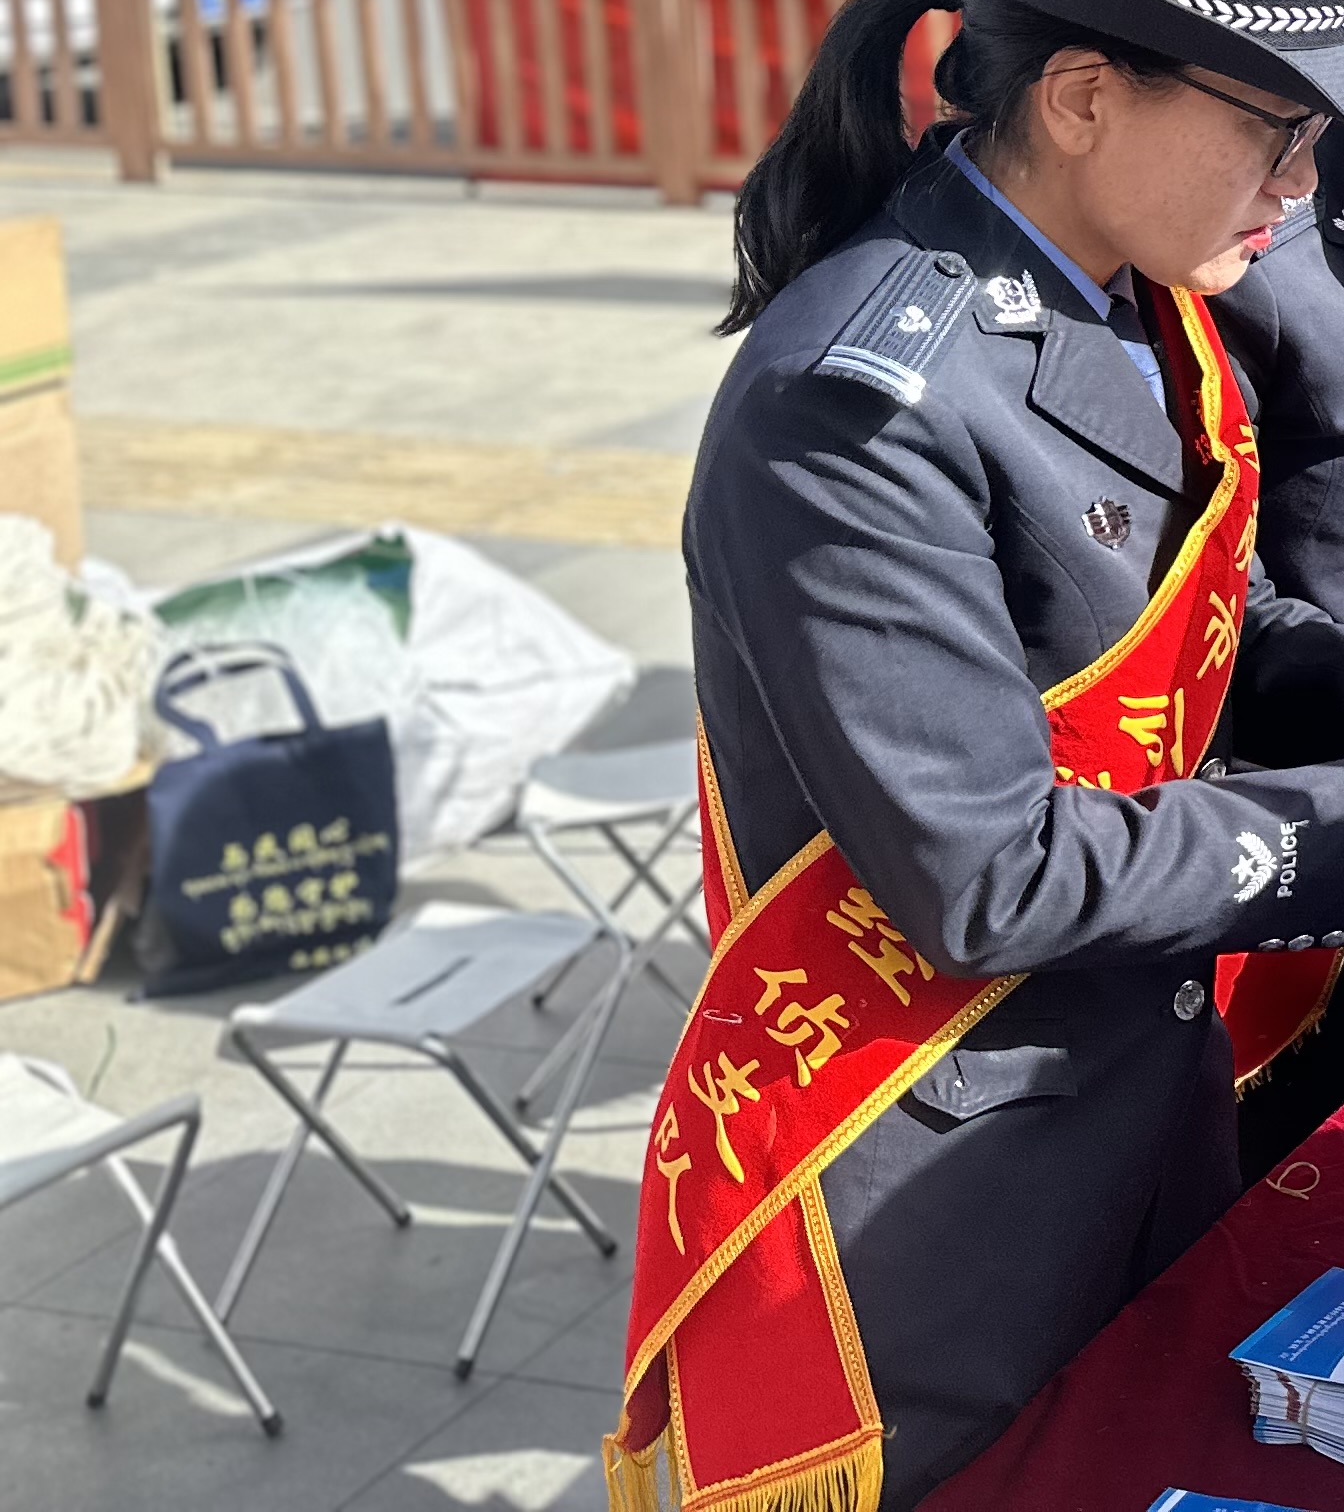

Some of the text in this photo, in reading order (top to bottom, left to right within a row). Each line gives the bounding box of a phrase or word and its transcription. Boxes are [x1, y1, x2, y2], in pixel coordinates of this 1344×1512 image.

[1277, 820, 1300, 898] POLICE
[655, 884, 938, 1255] 经侦支队
